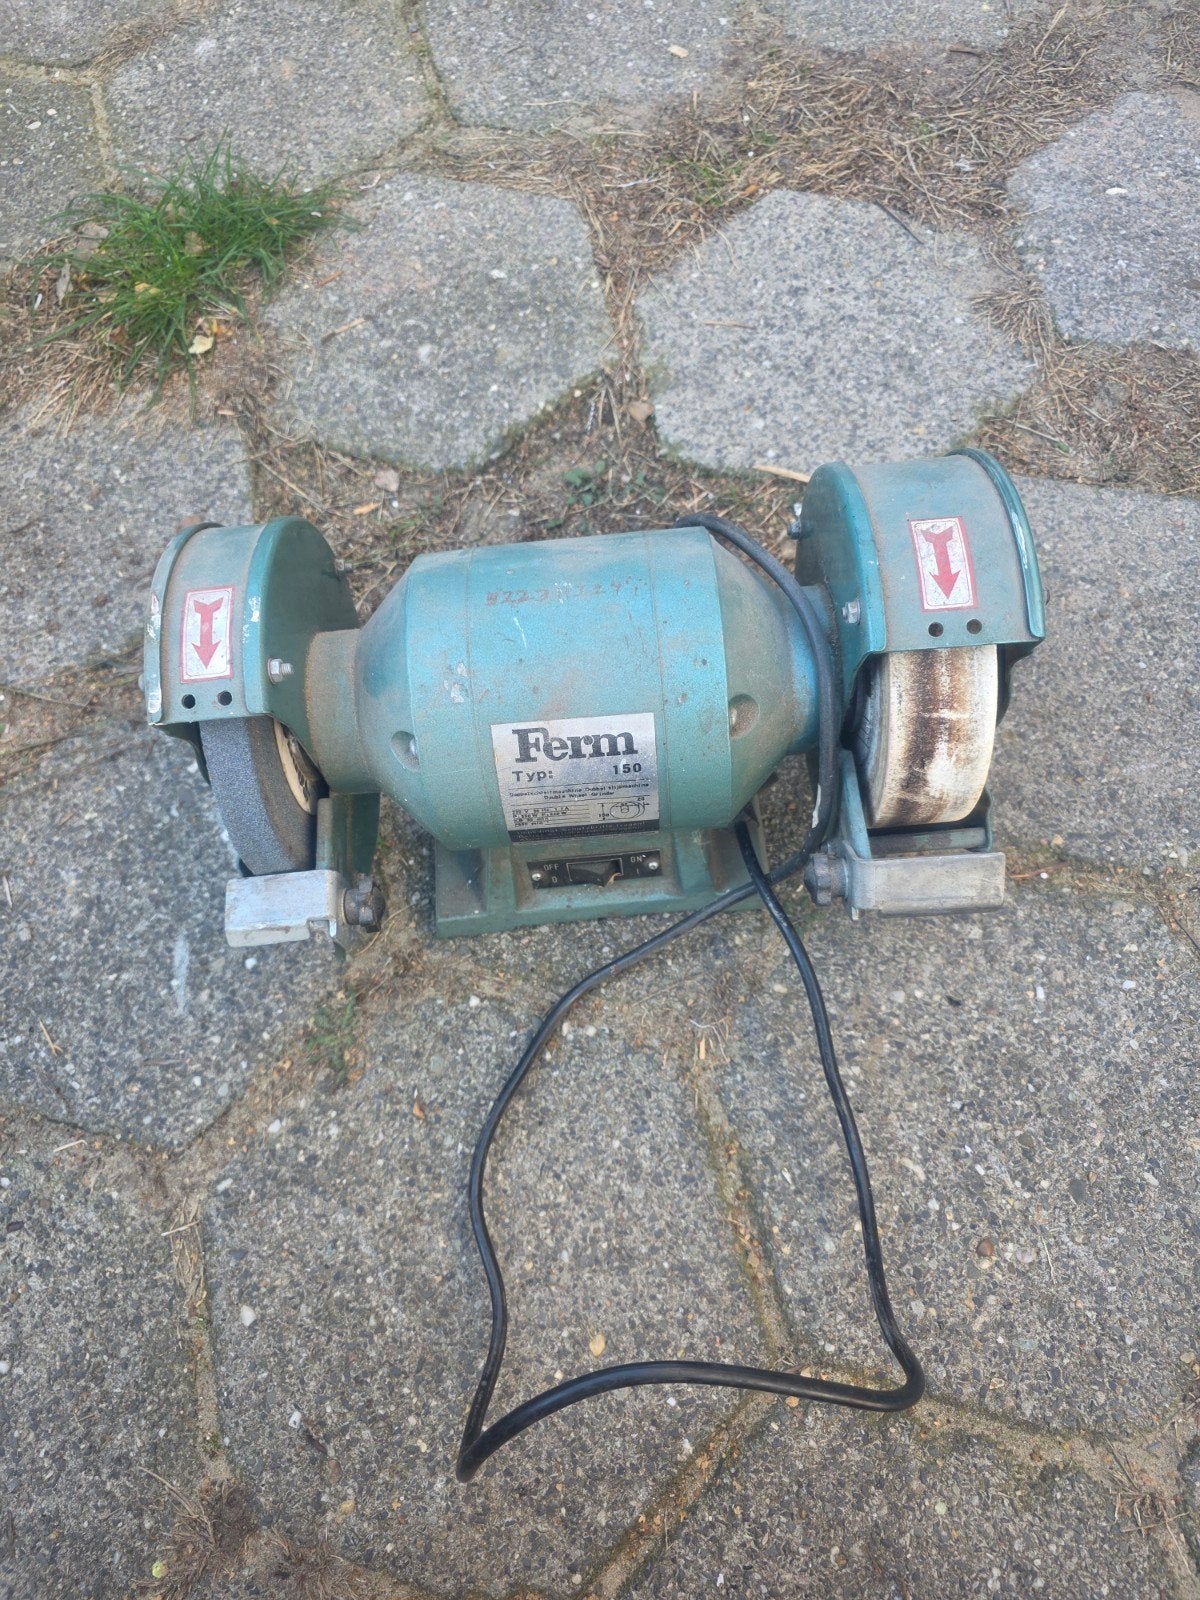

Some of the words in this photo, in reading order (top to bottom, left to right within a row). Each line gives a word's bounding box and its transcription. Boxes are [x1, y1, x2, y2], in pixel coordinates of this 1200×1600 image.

[512, 727, 638, 763] Ferm
[512, 770, 554, 782] Typ:
[612, 762, 642, 775] 150
[543, 863, 559, 871] OFF
[630, 855, 643, 863] ON
